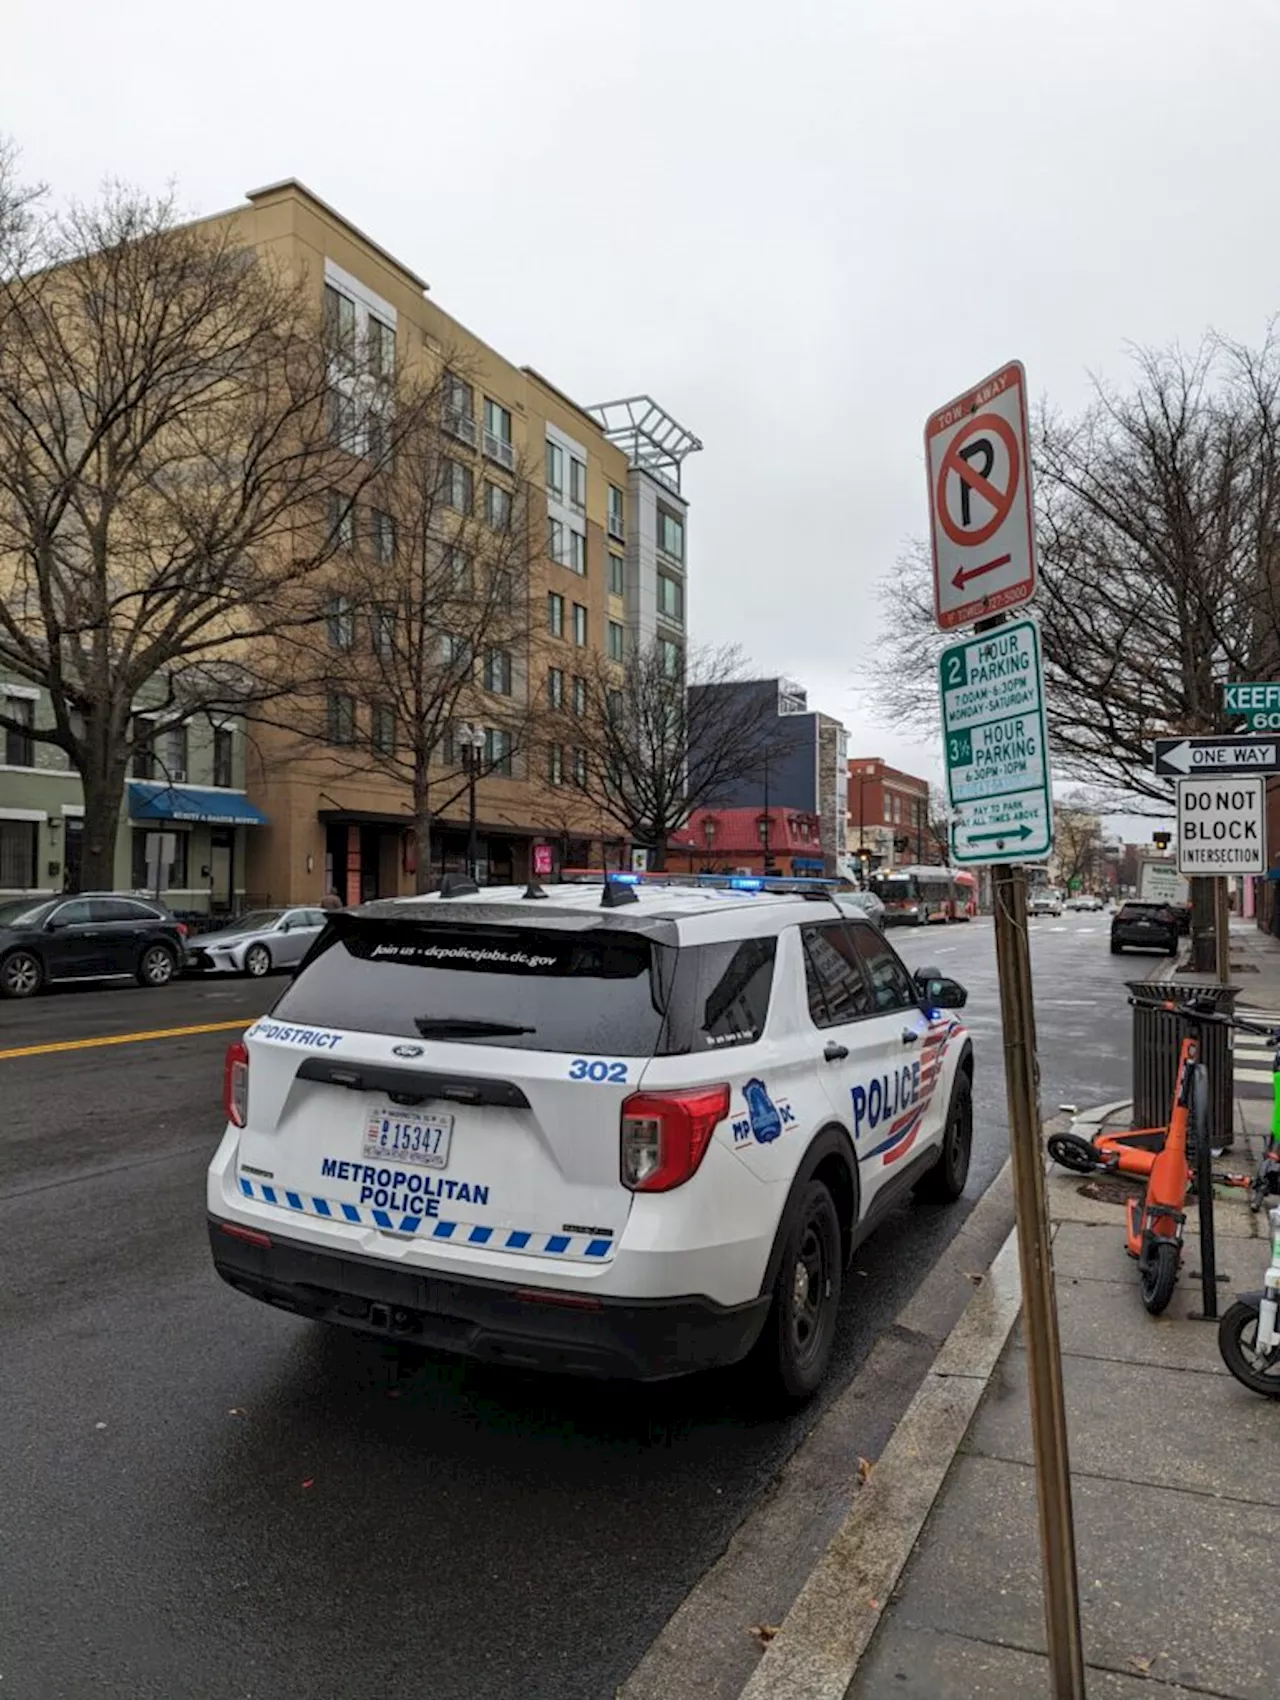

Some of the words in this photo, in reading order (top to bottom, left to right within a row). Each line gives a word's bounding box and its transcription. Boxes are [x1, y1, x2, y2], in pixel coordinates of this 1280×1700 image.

[938, 403, 963, 429] TOW
[975, 373, 1008, 406] AWAY
[978, 635, 1018, 664] HOUR
[947, 656, 963, 685] 2
[970, 651, 1029, 685] PARKING
[983, 720, 1025, 745] HOUR
[976, 737, 1035, 768] PARKING
[1192, 748, 1226, 764] ONE
[1234, 747, 1270, 763] WAY
[974, 806, 988, 815] PAY
[990, 804, 1000, 813] TO
[1003, 801, 1024, 811] PARK
[1185, 792, 1211, 811] DO
[1216, 791, 1256, 810] NOT
[1014, 808, 1039, 821] ABOVE
[1184, 820, 1257, 840] BLOCK
[1183, 848, 1260, 863] INTERSECTION
[399, 946, 416, 955] us
[267, 1025, 343, 1049] DISTRICT
[569, 1059, 628, 1084] 302
[850, 1060, 920, 1140] POLICE
[393, 1123, 442, 1154] 15347
[732, 1119, 750, 1142] MP
[321, 1158, 490, 1205] METROPOLITAN
[360, 1186, 440, 1218] POLICE
